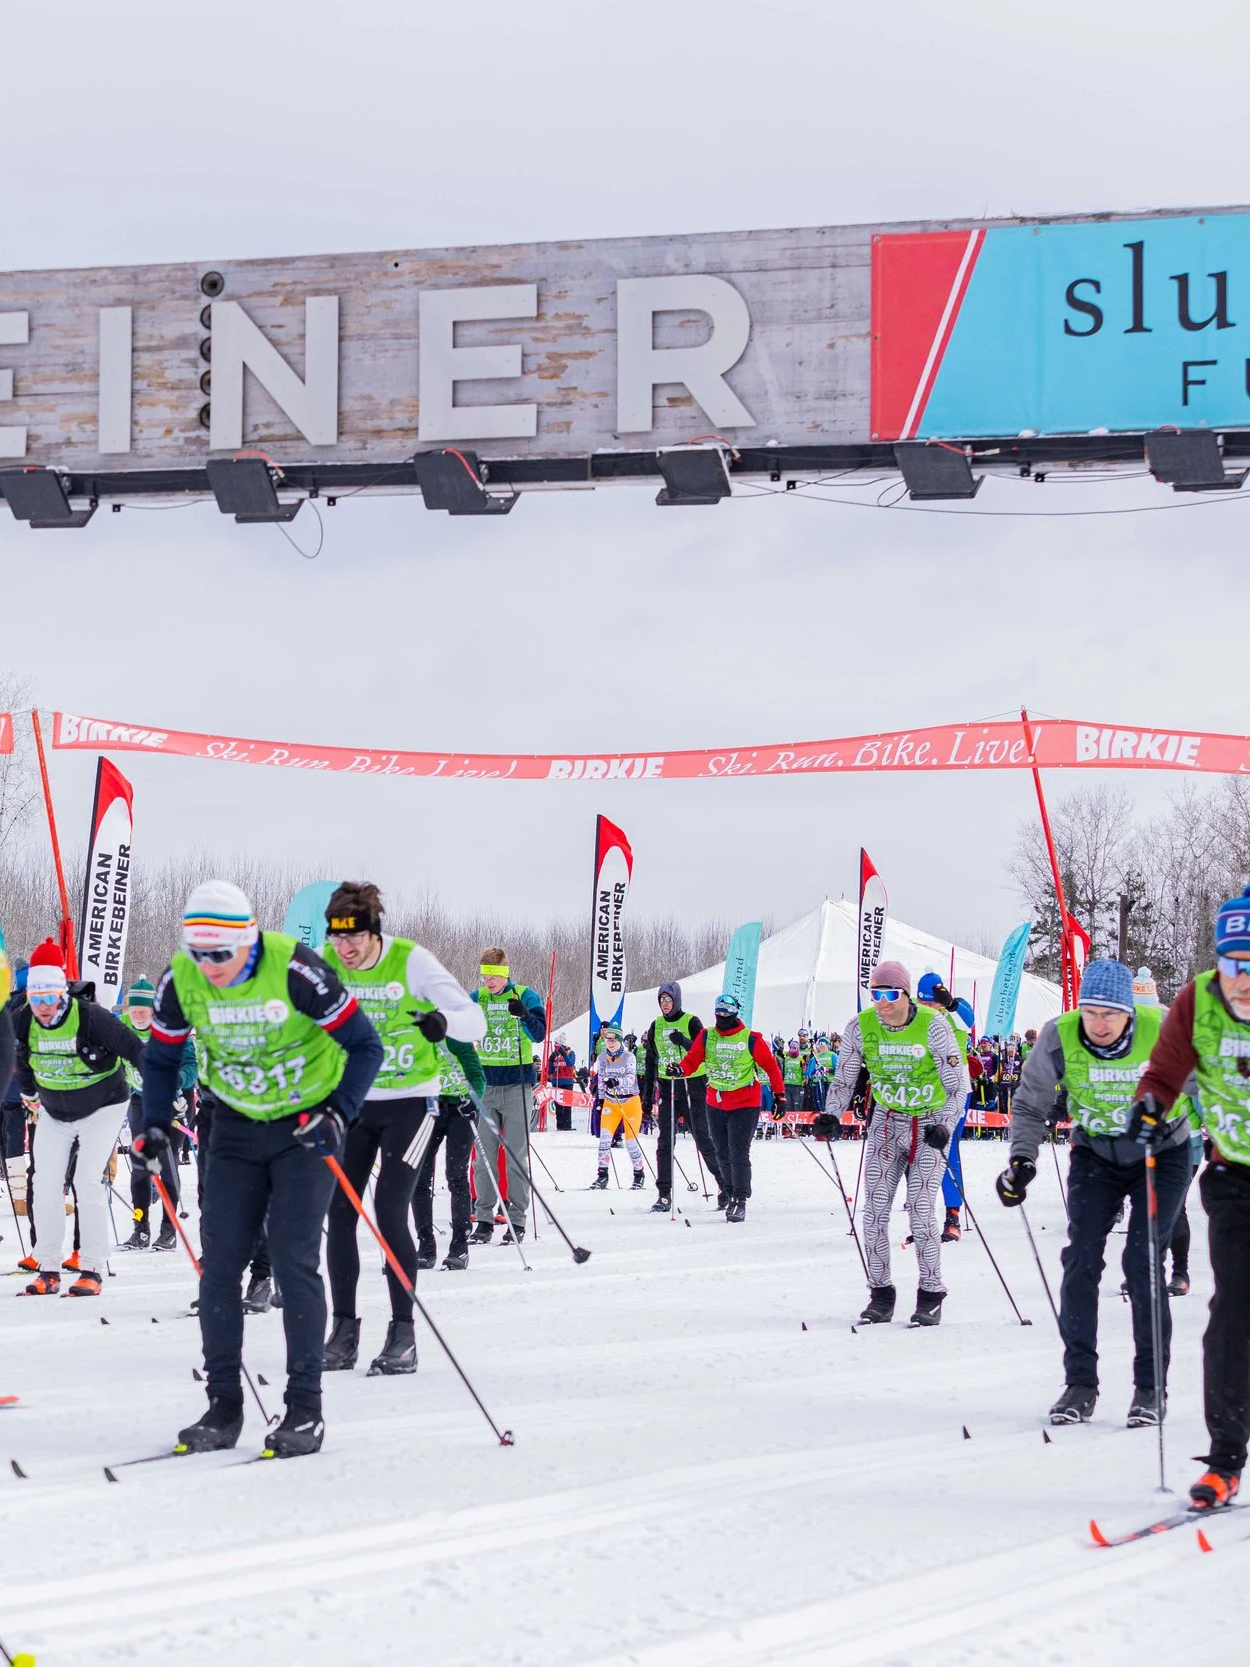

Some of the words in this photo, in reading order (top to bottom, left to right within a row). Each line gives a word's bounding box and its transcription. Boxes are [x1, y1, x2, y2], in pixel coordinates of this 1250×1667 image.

[59, 712, 167, 748] BIRKIE
[547, 756, 665, 780] BIRKIE
[766, 751, 844, 773] Run.
[851, 733, 938, 768] Bike.
[946, 726, 1042, 766] Live!
[1076, 724, 1202, 768] BIRKIE
[87, 852, 114, 968] AMERICAN
[103, 842, 132, 987] BIRKEBEINER
[596, 889, 612, 981] AMERICAN
[860, 911, 873, 990] AMERICAN
[209, 1005, 266, 1025] BIRKIE
[879, 1045, 913, 1056] BIRKIE
[872, 1081, 935, 1108] 16429
[1090, 1068, 1141, 1083] BIRKIE
